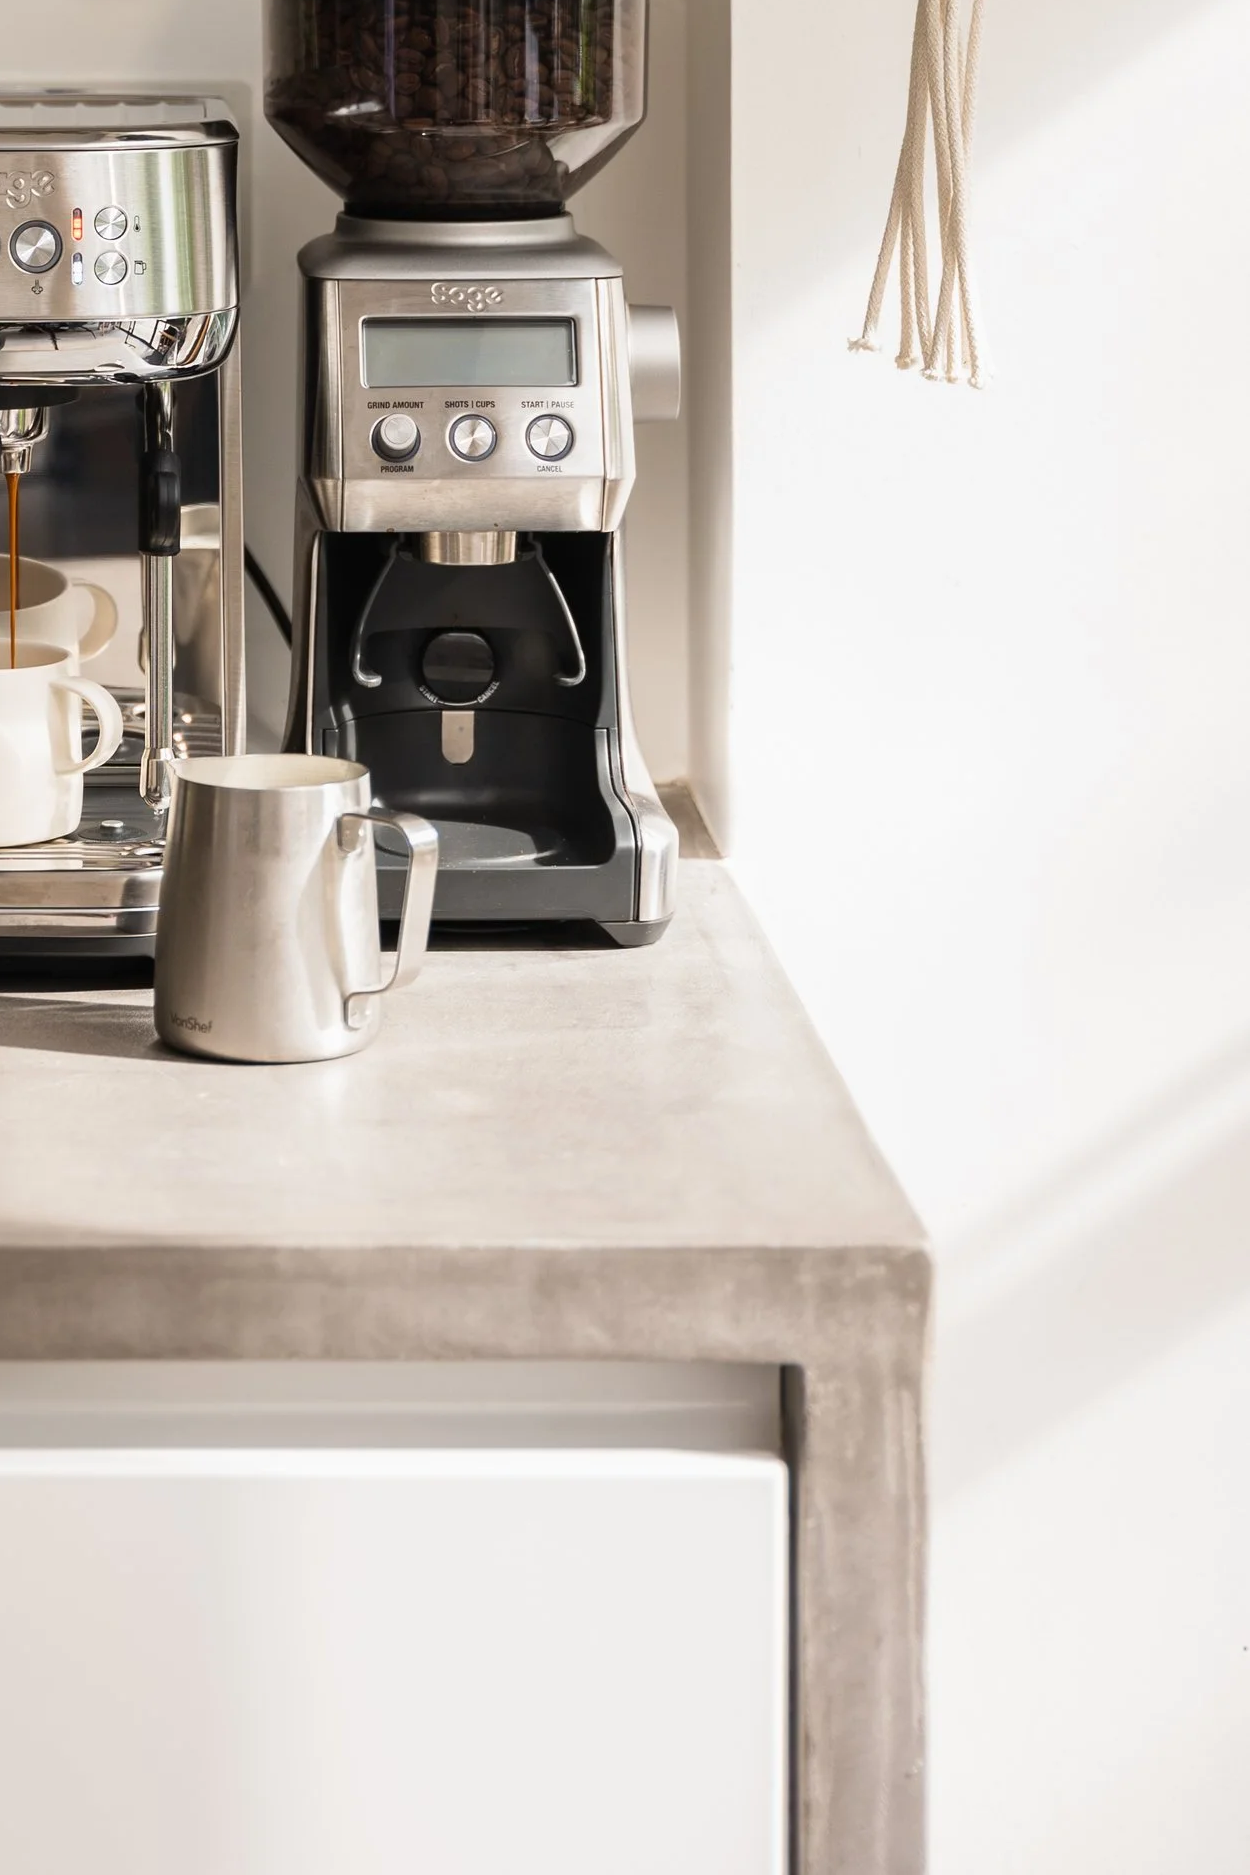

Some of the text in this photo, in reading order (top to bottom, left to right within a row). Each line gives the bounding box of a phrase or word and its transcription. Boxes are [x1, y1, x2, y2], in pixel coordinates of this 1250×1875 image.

[430, 282, 505, 314] Sage
[367, 401, 424, 409] GRIND AMOUNT
[444, 400, 496, 409] SHOTS CUPS
[521, 400, 575, 408] START PAUSE
[380, 465, 415, 473] PROGRAM
[536, 465, 563, 473] CANCEL
[476, 681, 500, 703] CANCEL
